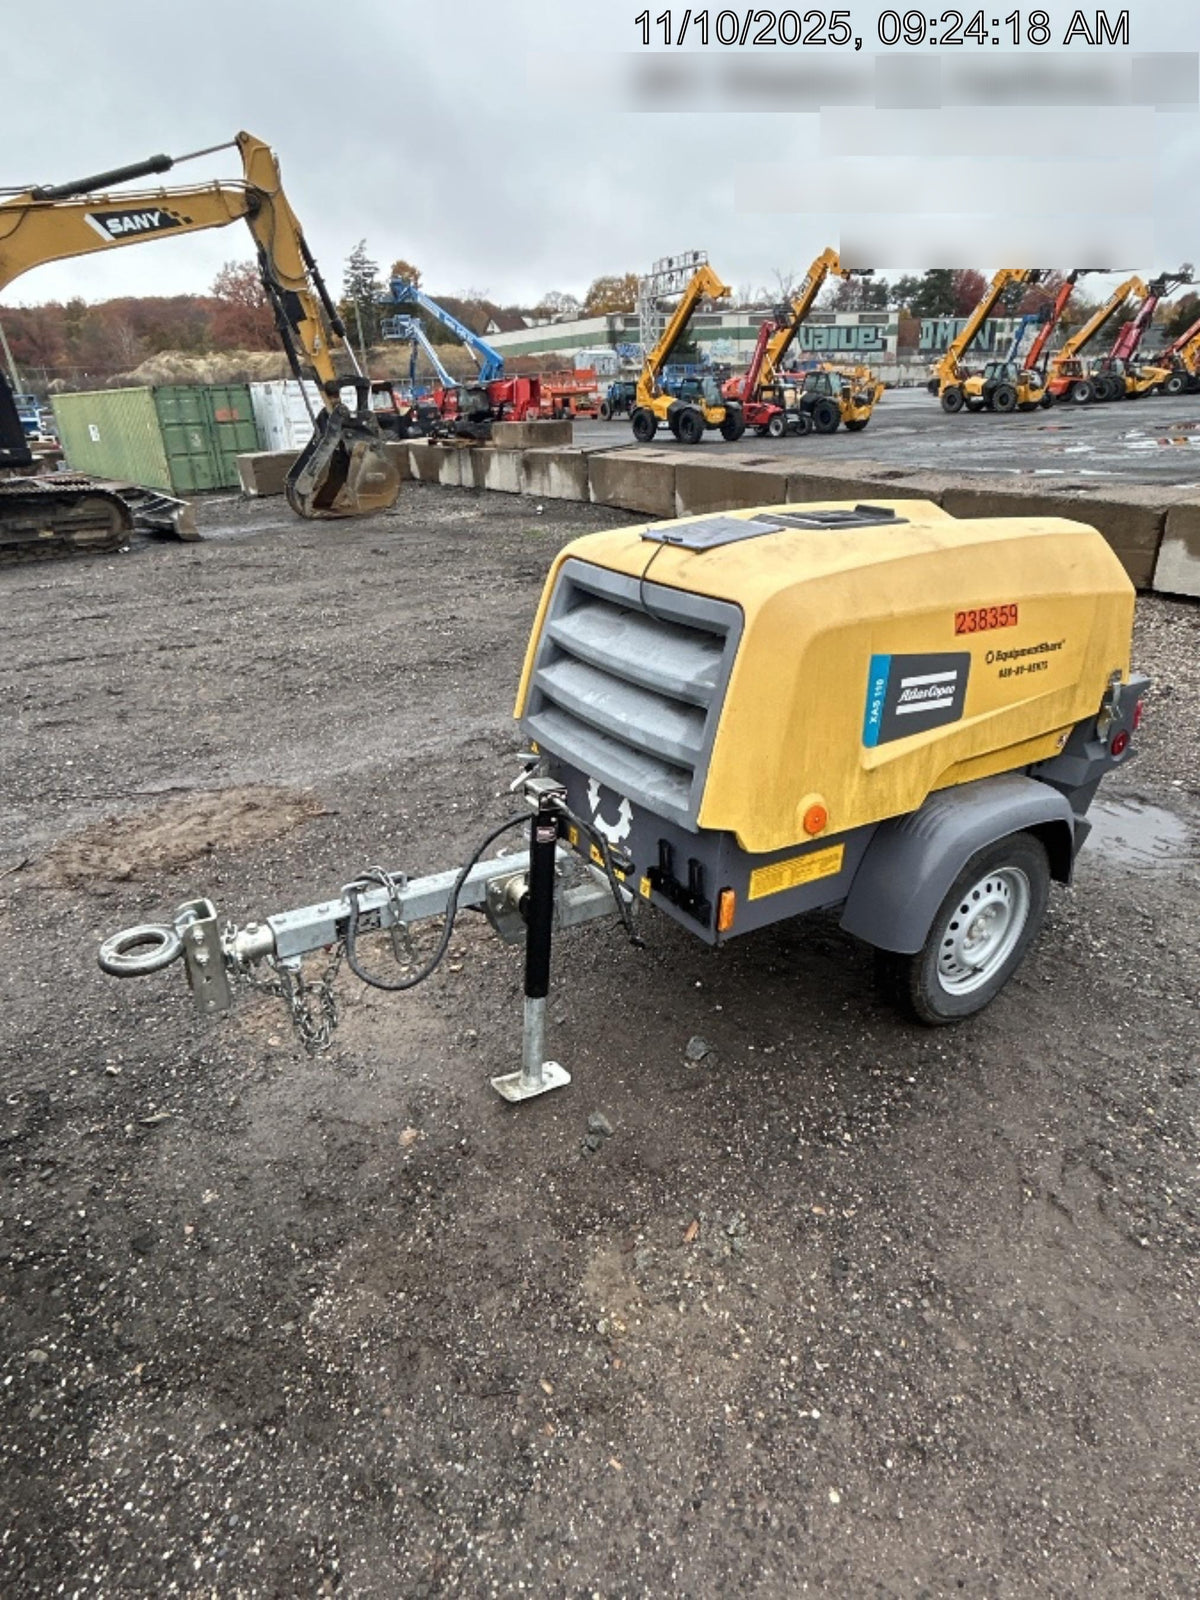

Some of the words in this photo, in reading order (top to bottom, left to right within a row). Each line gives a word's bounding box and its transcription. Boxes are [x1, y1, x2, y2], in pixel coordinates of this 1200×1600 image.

[106, 211, 160, 234] SANY
[956, 603, 1018, 634] 238359
[869, 700, 881, 724] XAS
